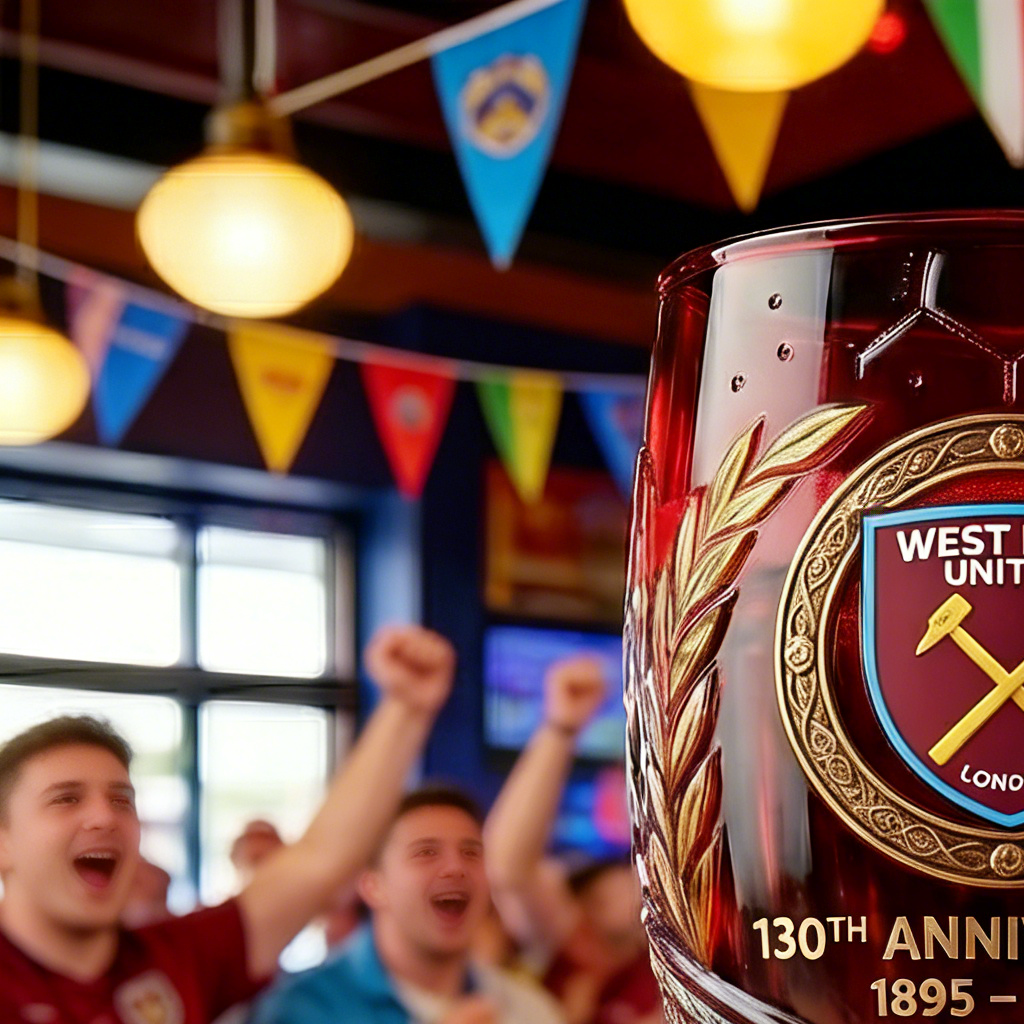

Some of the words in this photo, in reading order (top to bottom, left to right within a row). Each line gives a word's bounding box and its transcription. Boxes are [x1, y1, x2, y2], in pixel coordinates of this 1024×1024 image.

[897, 524, 1011, 564] WEST
[752, 916, 868, 961] 130TH
[870, 978, 975, 1018] 1895
